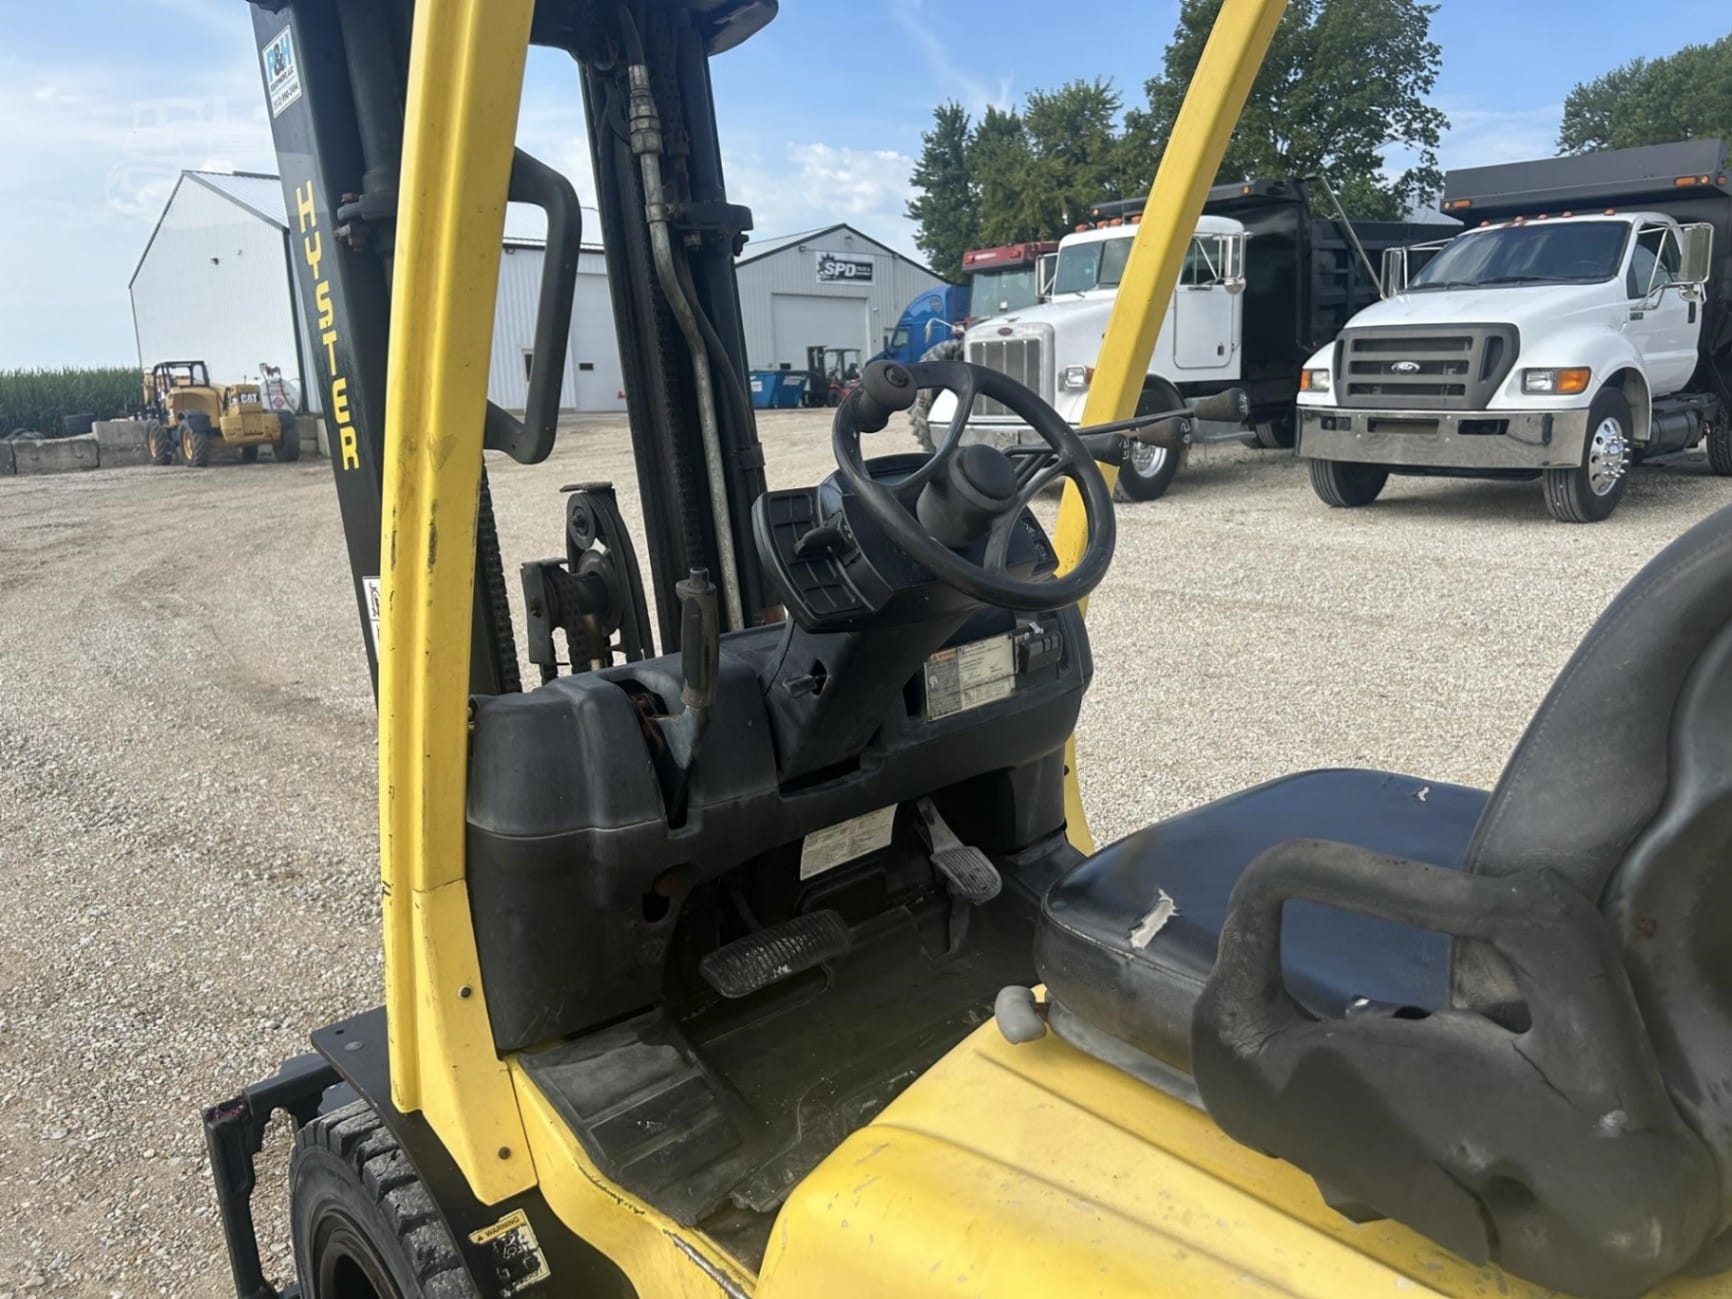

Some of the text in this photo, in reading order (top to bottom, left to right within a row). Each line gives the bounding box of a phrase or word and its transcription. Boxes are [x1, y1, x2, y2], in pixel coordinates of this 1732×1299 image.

[824, 262, 857, 277] SPD
[296, 179, 360, 470] HYSTER
[240, 393, 257, 404] CAT
[484, 1216, 520, 1237] WARNING
